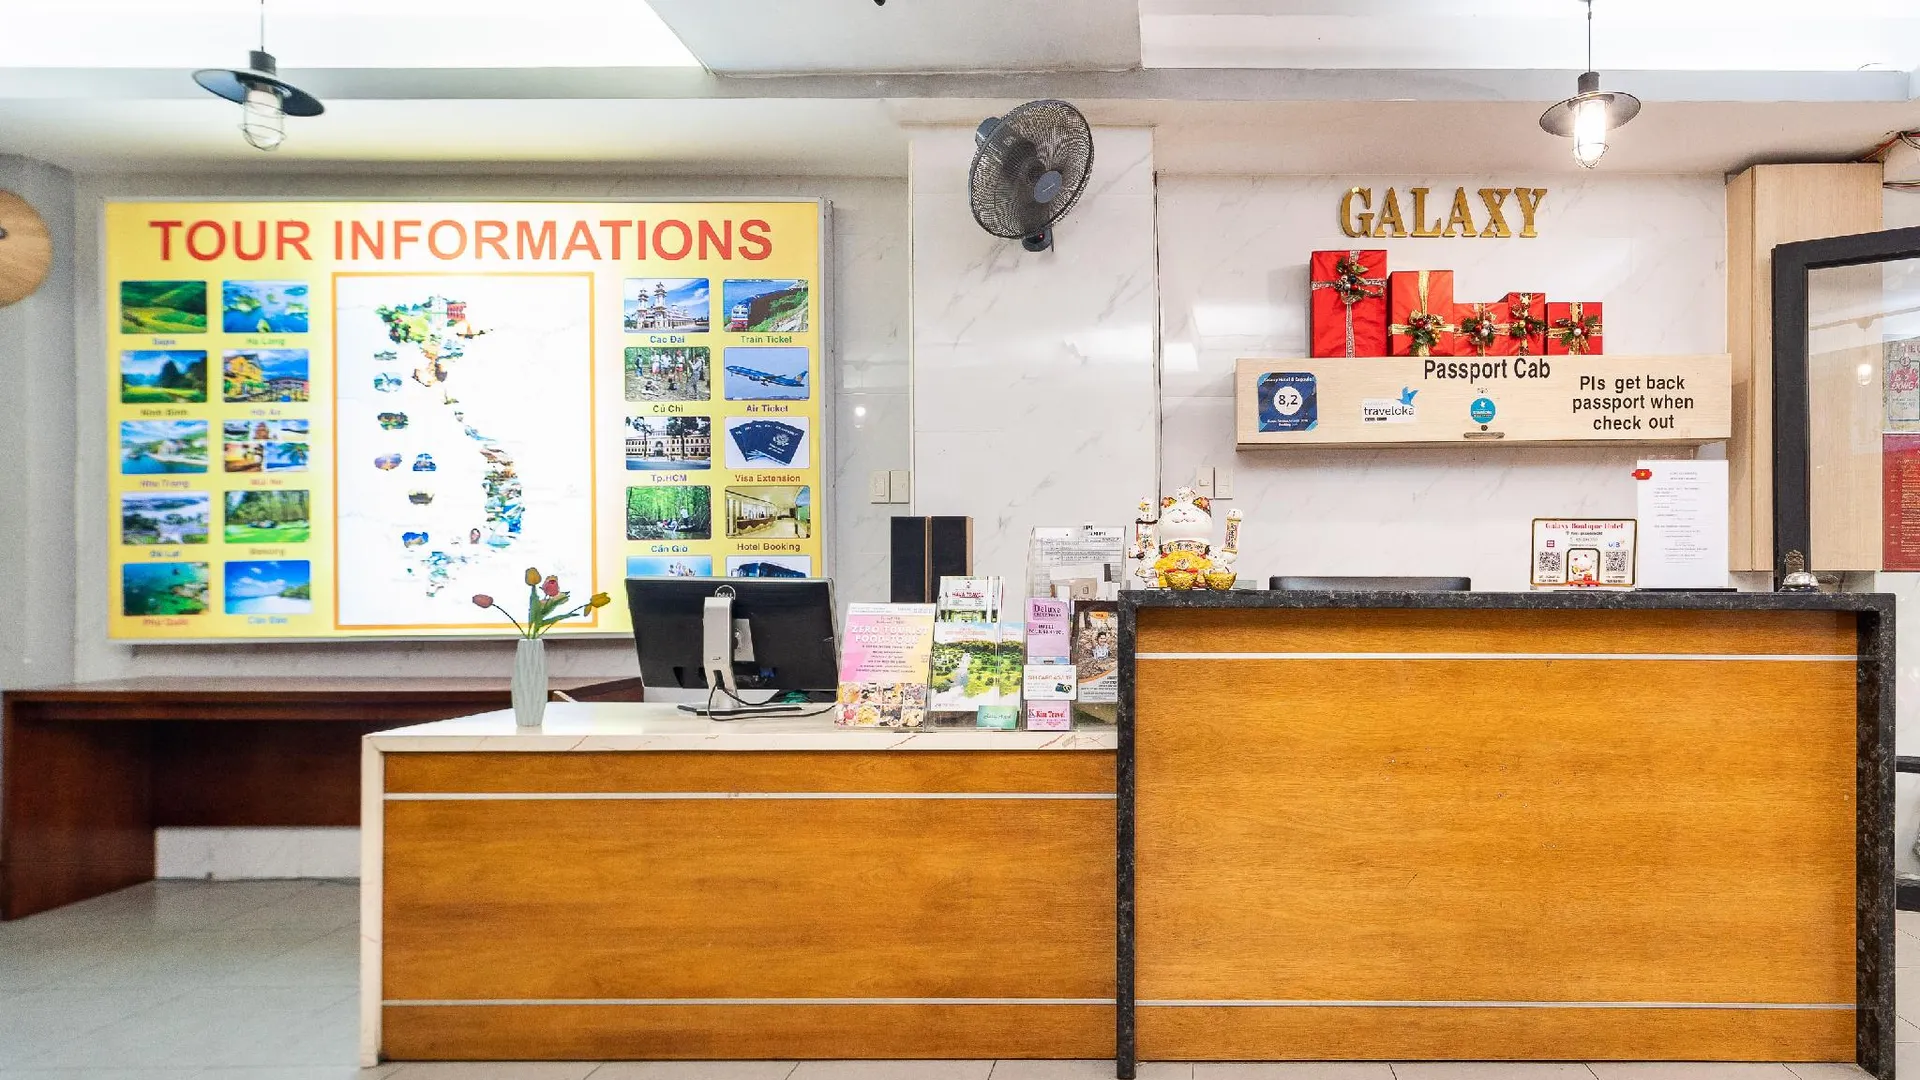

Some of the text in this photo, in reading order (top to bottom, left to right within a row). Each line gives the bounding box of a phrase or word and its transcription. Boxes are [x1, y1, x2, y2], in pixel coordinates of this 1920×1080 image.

[1340, 186, 1548, 238] GALAXY
[148, 219, 773, 261] TOUR INFORMATIONS
[650, 335, 668, 344] Cao
[740, 335, 793, 343] Train Ticket
[1424, 357, 1551, 384] Passport Cab
[1580, 375, 1685, 393] Pls get back
[1278, 394, 1298, 407] 8,2
[1573, 394, 1694, 413] passport when
[668, 404, 684, 413] Chi
[746, 404, 788, 412] Air Ticket
[1364, 405, 1415, 416] traveloka
[1593, 415, 1675, 430] check out
[651, 474, 687, 483] Tp.HCM
[735, 474, 801, 482] Visa Extension
[737, 543, 801, 552] Hotel Booking
[1034, 604, 1062, 613] Deluxe
